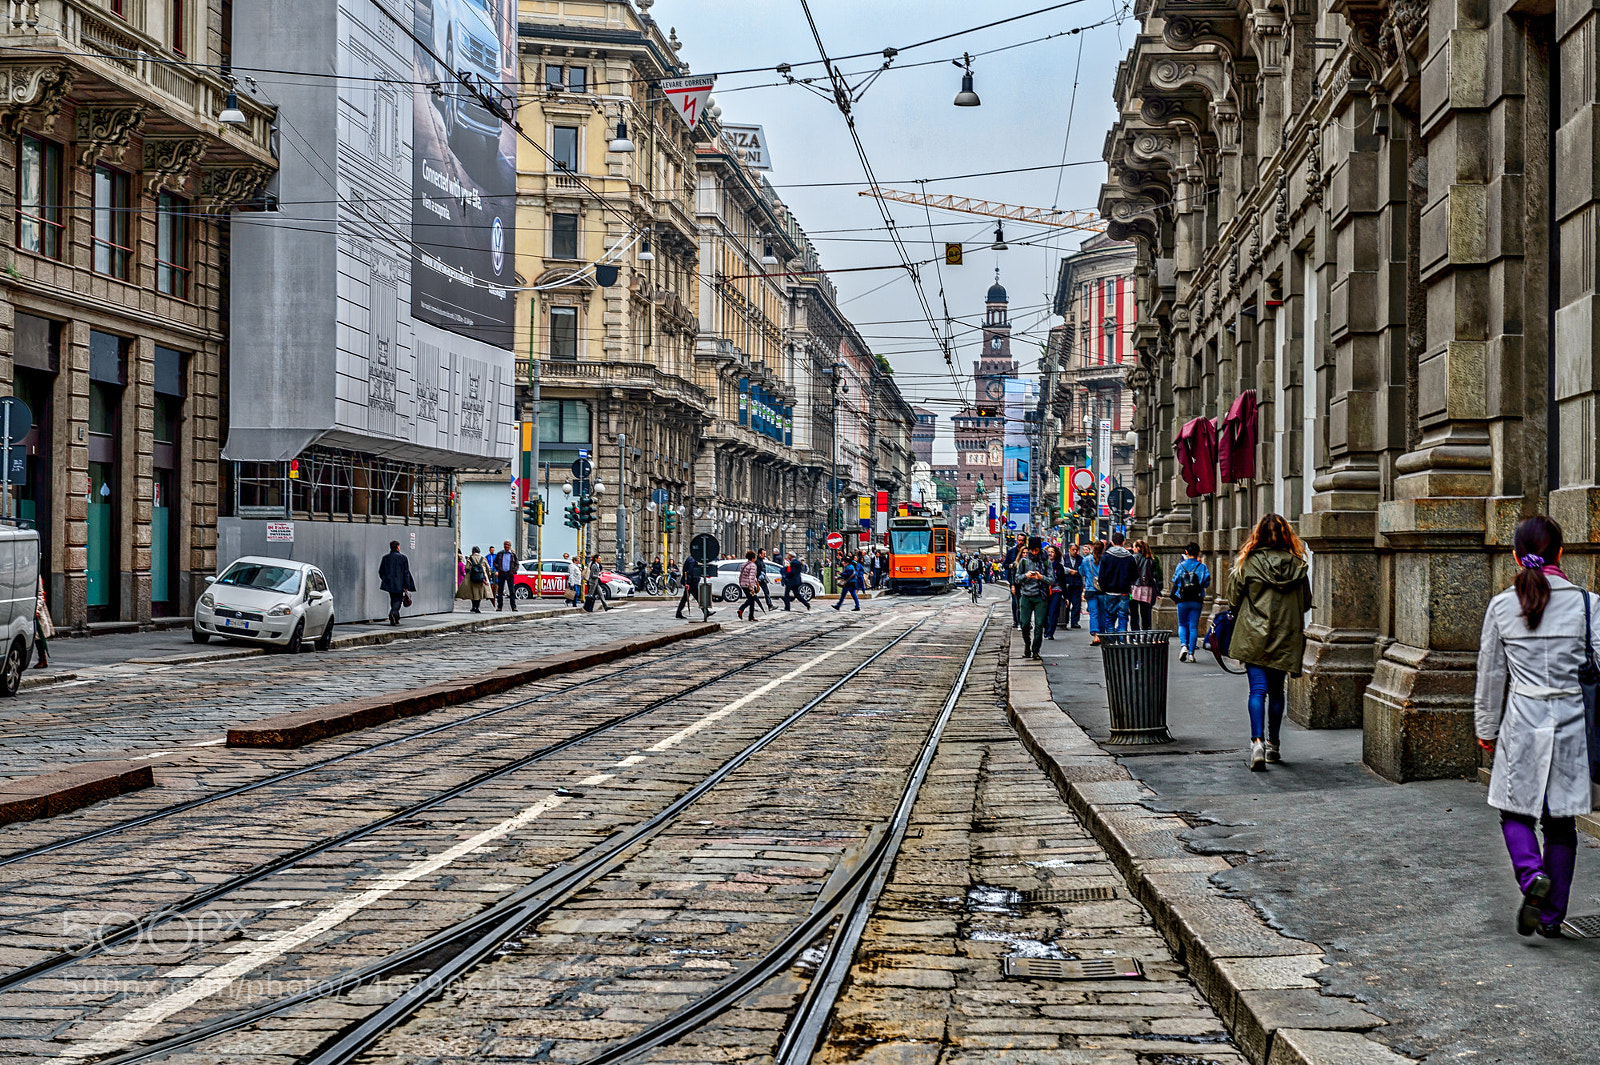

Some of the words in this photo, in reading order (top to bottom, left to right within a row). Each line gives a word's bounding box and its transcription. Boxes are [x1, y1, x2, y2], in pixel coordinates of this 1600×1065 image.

[662, 80, 682, 89] LEVARE
[684, 77, 714, 87] CORRENTE
[422, 158, 449, 193] Connected
[449, 176, 461, 200] with
